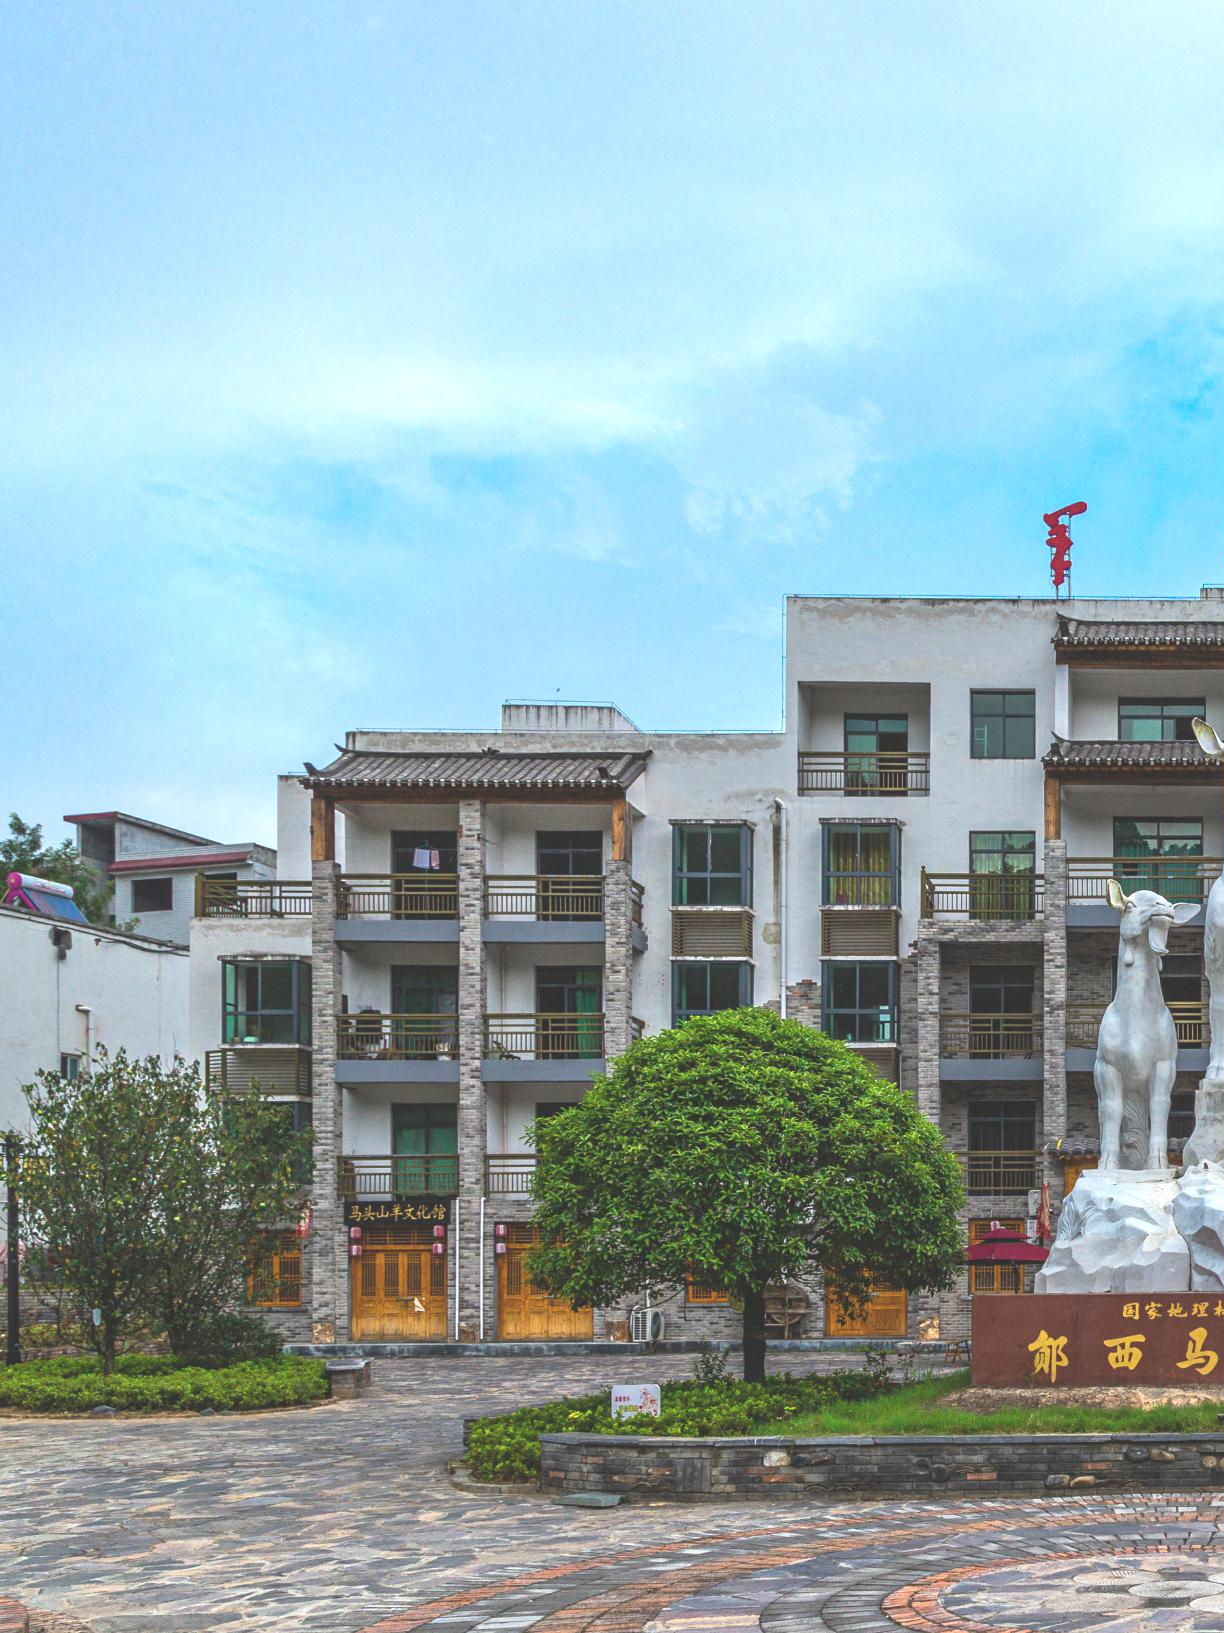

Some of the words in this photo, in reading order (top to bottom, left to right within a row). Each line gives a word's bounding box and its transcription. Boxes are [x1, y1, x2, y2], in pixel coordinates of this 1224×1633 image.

[348, 1203, 447, 1222] 马头山羊文化馆
